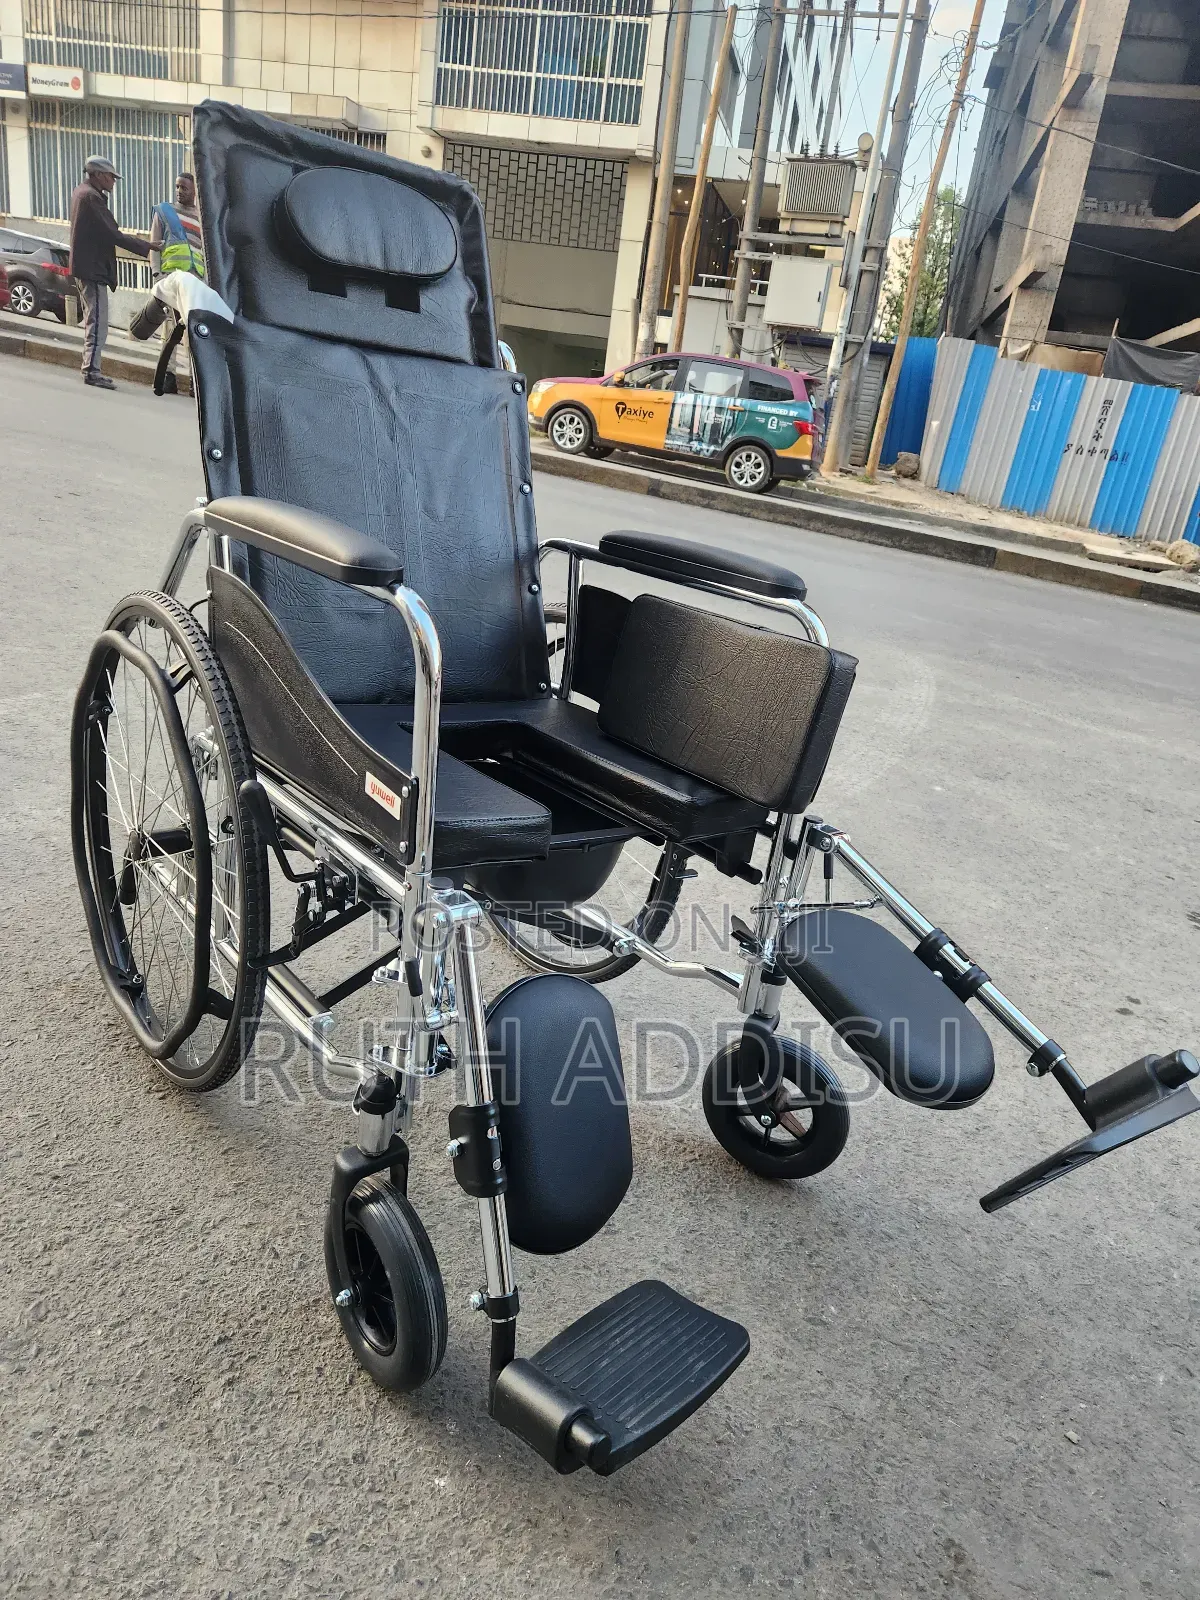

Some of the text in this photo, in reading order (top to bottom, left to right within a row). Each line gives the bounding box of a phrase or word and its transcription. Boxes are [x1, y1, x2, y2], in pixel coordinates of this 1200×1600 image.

[32, 76, 69, 87] MoneyGram
[615, 401, 655, 419] Taxiye
[757, 404, 788, 415] FINANCED
[370, 781, 396, 808] yuwell
